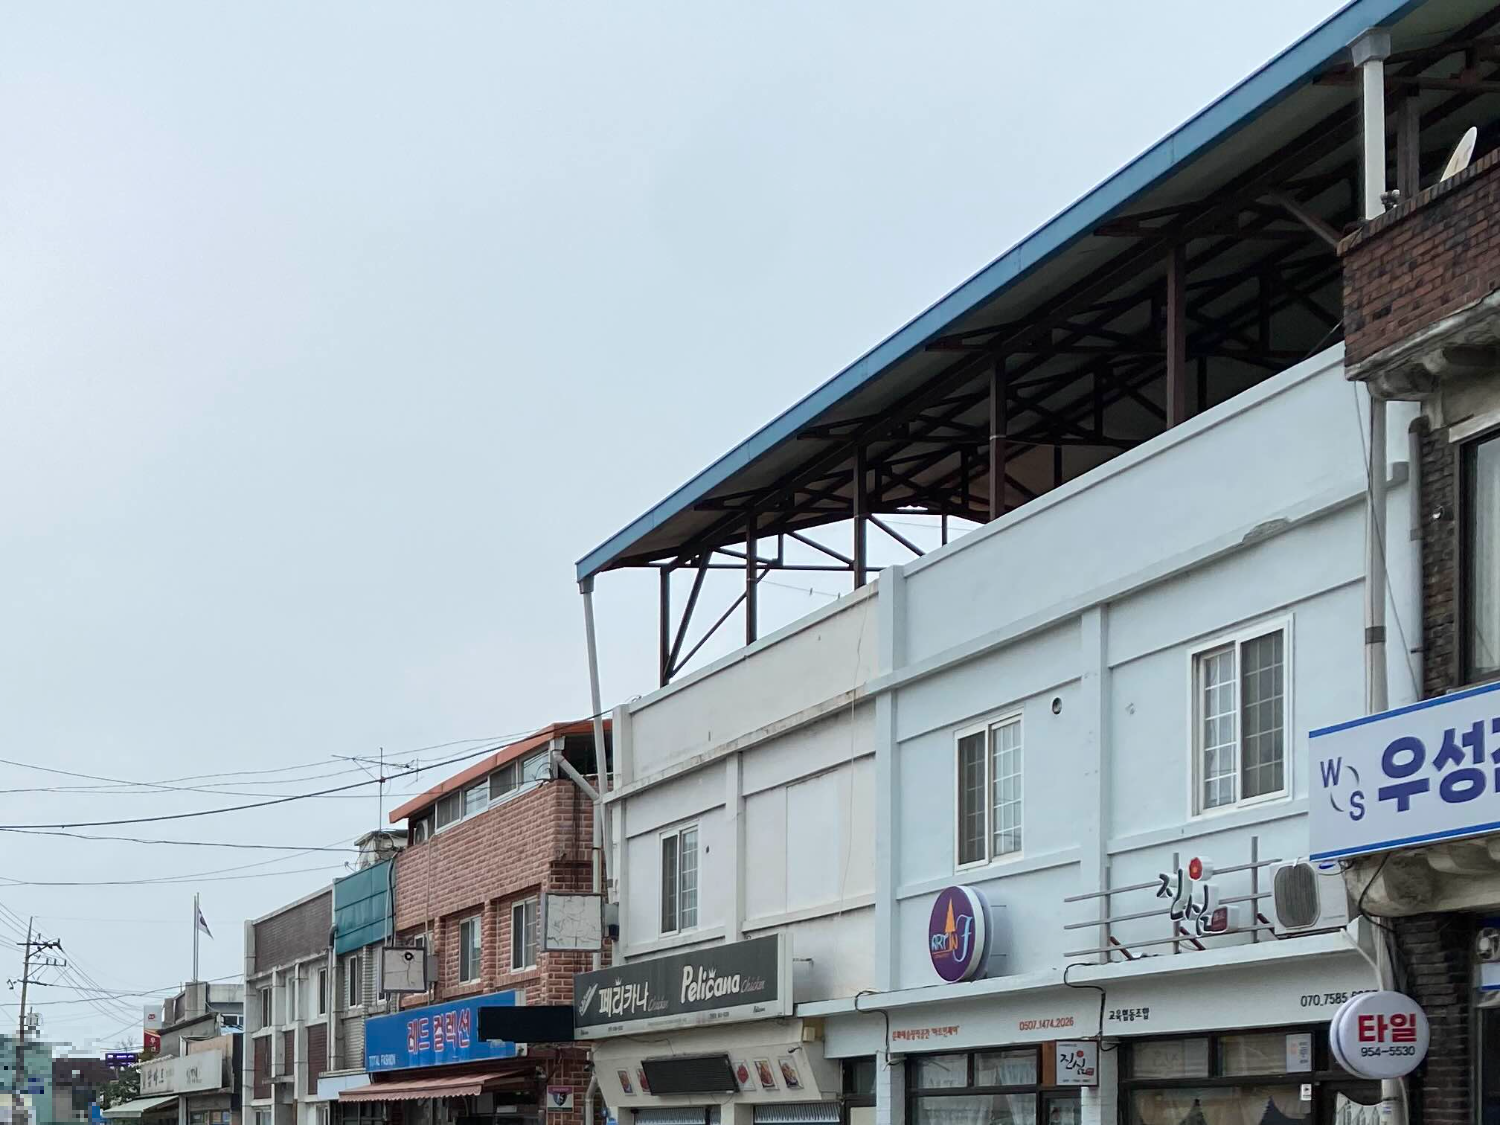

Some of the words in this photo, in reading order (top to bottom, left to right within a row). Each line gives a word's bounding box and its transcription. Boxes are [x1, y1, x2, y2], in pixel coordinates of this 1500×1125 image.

[1378, 717, 1500, 813] 우성
[599, 980, 649, 1018] 페리카나
[680, 965, 741, 1004] Pelicana
[407, 1016, 430, 1053] 레드
[433, 1008, 471, 1053] 컬렉션
[1358, 1013, 1417, 1043] 타일
[1361, 1046, 1416, 1057] 954-5530
